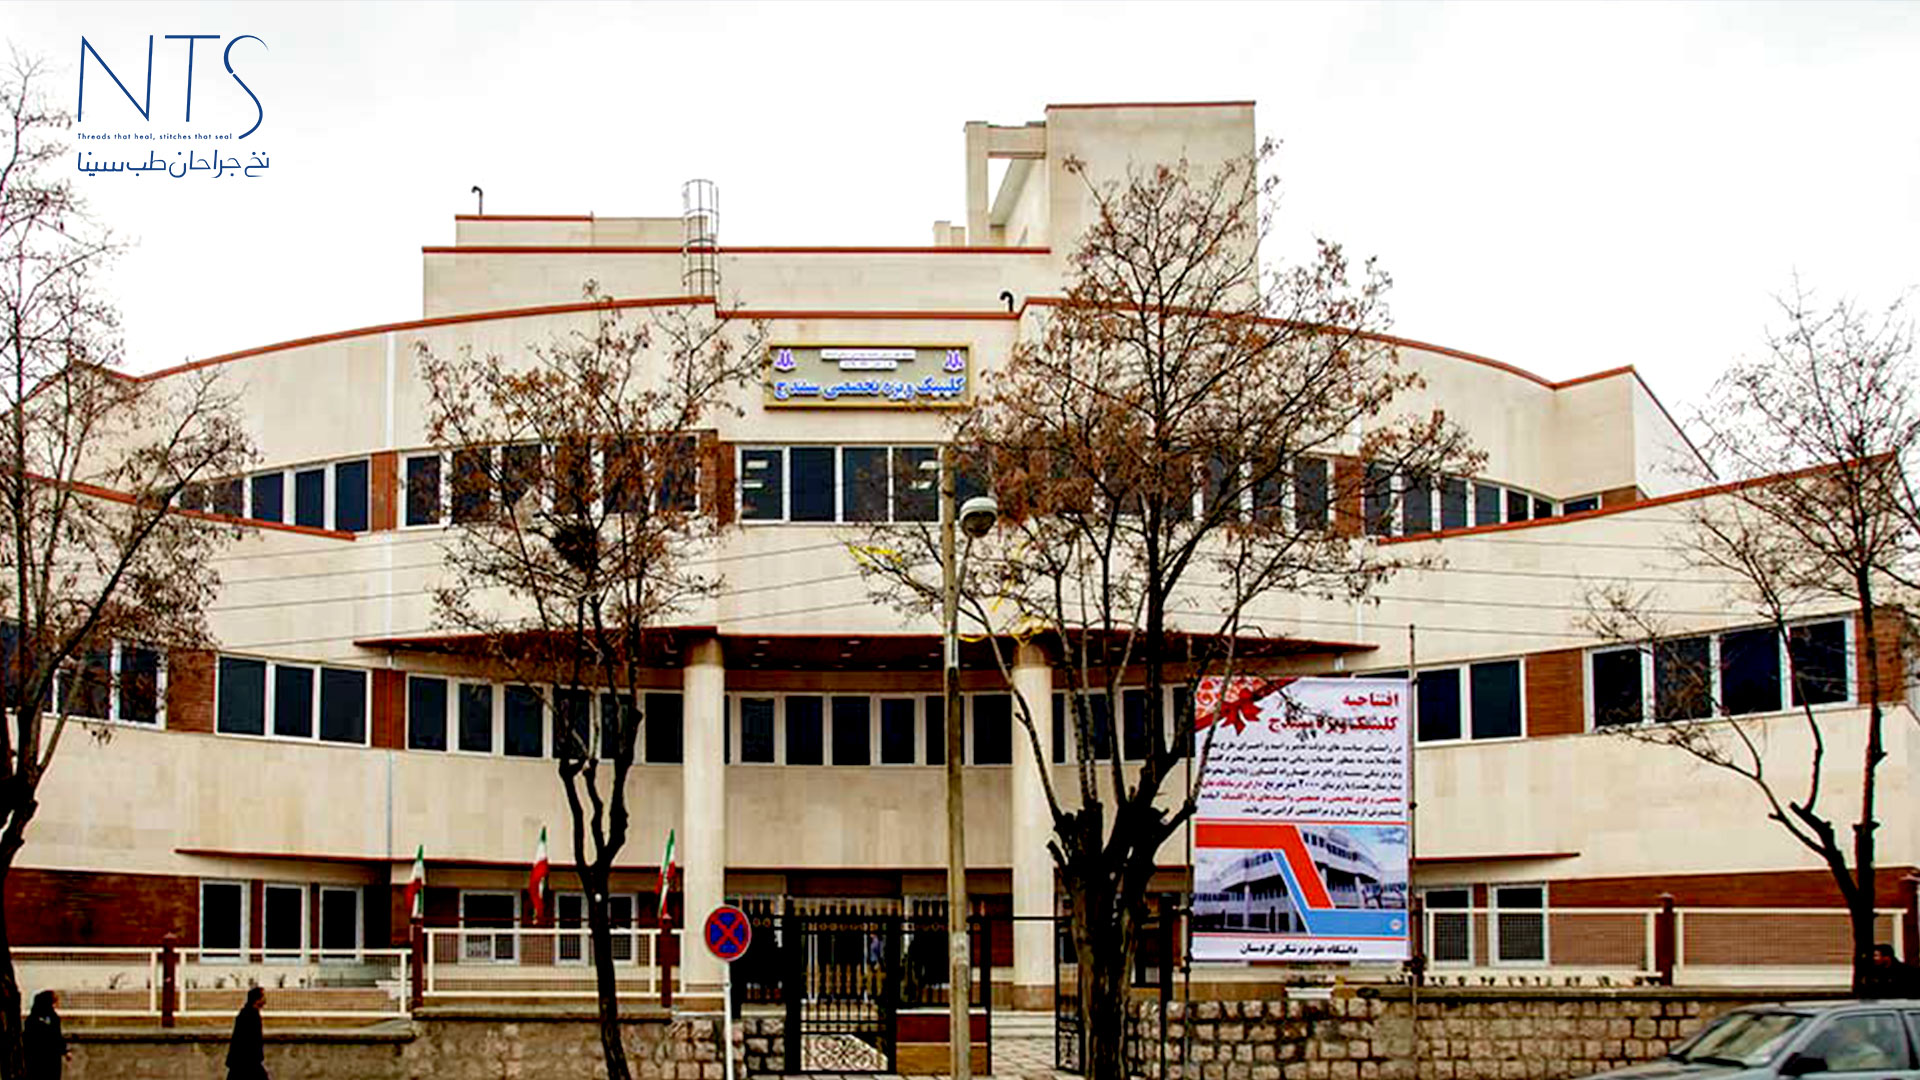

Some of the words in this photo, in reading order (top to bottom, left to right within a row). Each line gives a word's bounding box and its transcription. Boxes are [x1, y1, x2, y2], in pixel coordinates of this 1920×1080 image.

[773, 380, 821, 399] سنندج
[823, 379, 879, 398] تخصصی
[882, 380, 915, 398] ویژه
[916, 377, 966, 396] کلینیک
[1343, 691, 1398, 713] افتتاحیه
[1348, 716, 1399, 735] کلینیک
[1240, 943, 1275, 954] کردستان
[1327, 945, 1358, 954] دانشگاه
